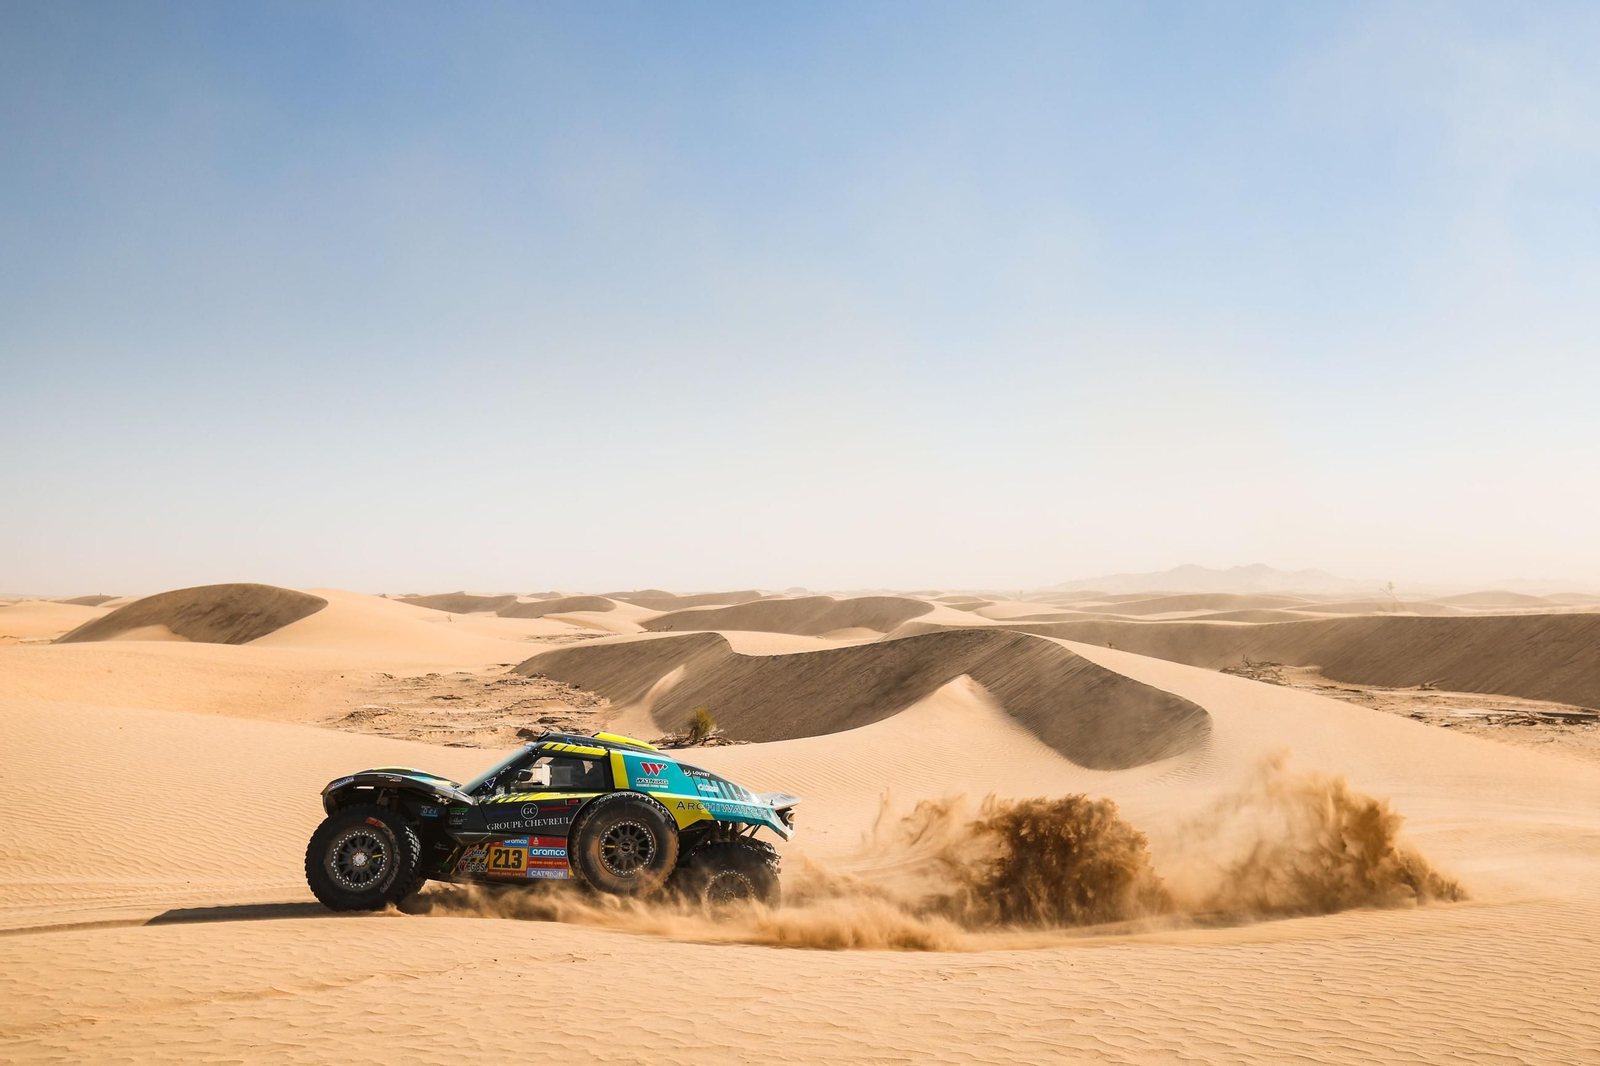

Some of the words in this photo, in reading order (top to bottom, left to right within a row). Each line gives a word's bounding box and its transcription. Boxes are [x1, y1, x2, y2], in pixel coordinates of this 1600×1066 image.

[523, 807, 536, 815] GC
[487, 821, 524, 831] GROUPE
[524, 817, 572, 828] CHEVREUL
[532, 848, 566, 856] aramco
[493, 849, 523, 869] 213
